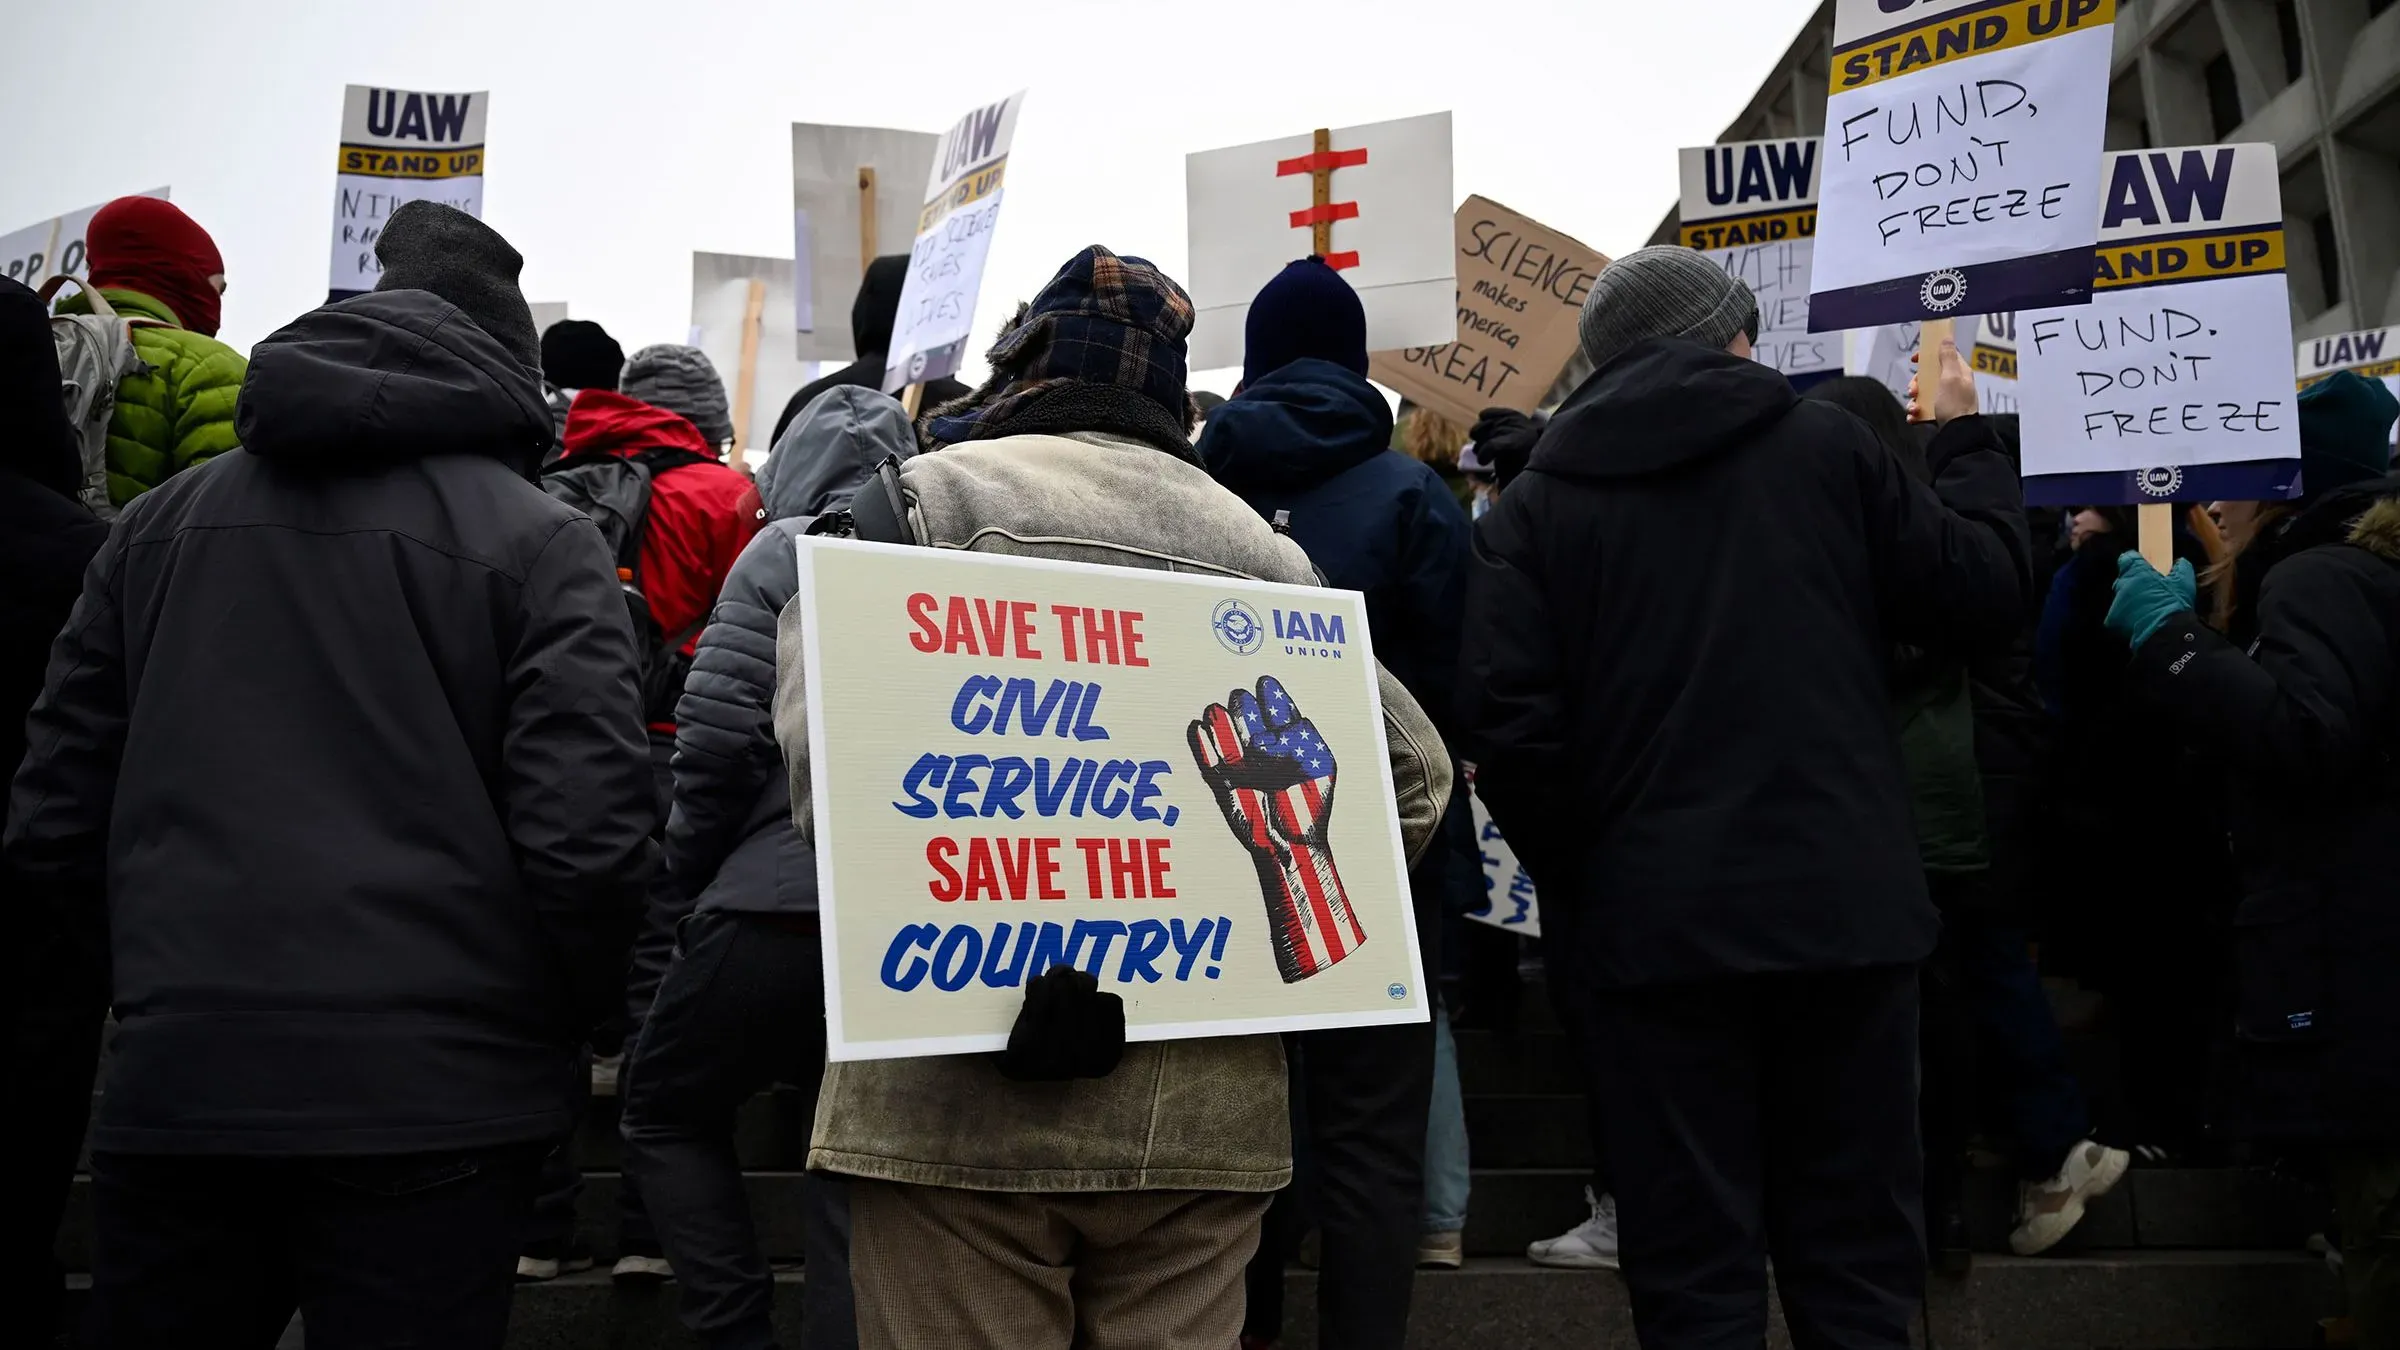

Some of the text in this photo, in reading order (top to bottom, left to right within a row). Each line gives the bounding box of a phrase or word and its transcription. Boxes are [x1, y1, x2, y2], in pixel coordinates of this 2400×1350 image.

[1842, 0, 2100, 86] STAND UP
[367, 88, 472, 142] UAW
[941, 97, 1011, 183] UAW
[1842, 79, 2038, 162] FUND,
[346, 151, 480, 174] STAND UP
[1705, 140, 1817, 206] UAW
[1872, 136, 2010, 201] DON'T
[2102, 148, 2235, 229] AW
[1691, 218, 1789, 250] STAND
[1878, 183, 2071, 247] FREEZE
[1461, 219, 1597, 308] SCIENCE
[2205, 239, 2270, 270] UP
[1456, 291, 1520, 350] merica
[1472, 279, 1529, 314] makes
[1933, 283, 1954, 296] UAW
[1976, 352, 2018, 377] STA
[2314, 330, 2388, 368] UAW
[2084, 401, 2281, 440] FREEZE
[907, 592, 1042, 660] SAVE
[1051, 604, 1150, 667] THE
[1273, 608, 1346, 644] IAM
[1284, 645, 1342, 659] UNION
[951, 674, 1110, 742] CIVIL
[892, 753, 1181, 827] SERVICE,
[926, 836, 1177, 903] SAVE THE
[879, 917, 1233, 993] COUNTRY!
